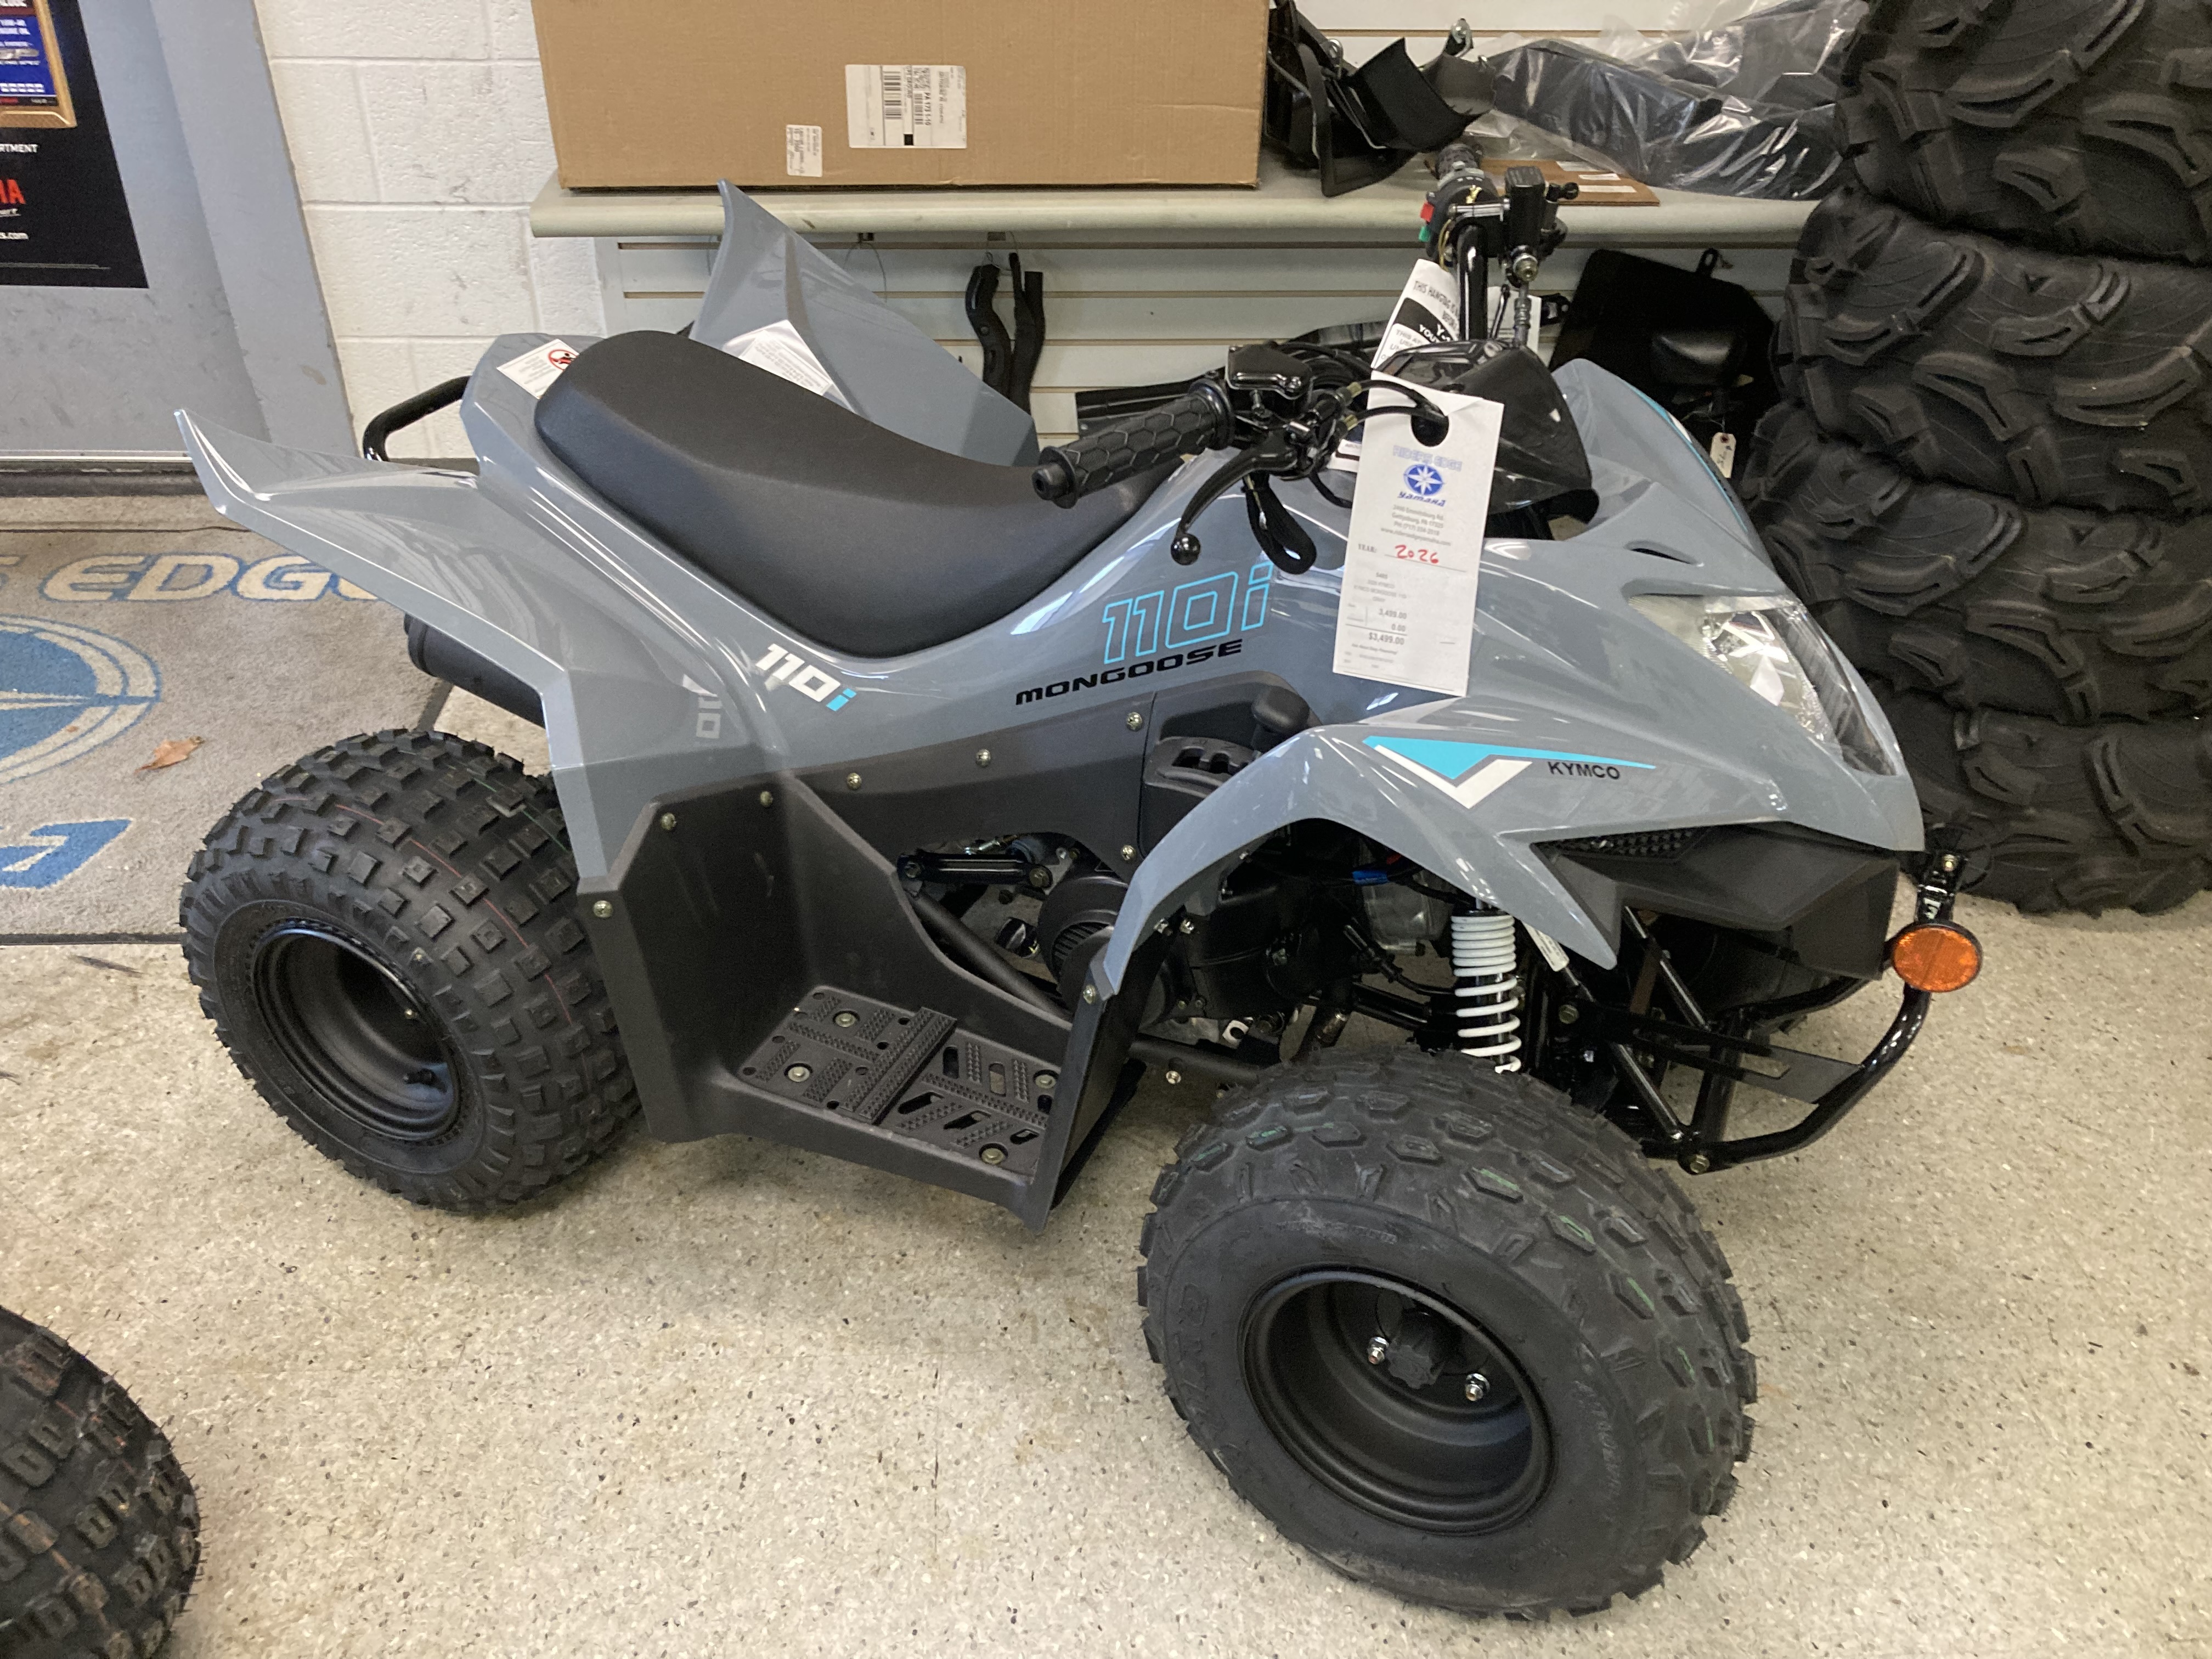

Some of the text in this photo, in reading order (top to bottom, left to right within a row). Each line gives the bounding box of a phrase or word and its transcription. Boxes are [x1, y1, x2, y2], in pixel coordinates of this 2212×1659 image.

[1394, 544, 1440, 565] 2026
[1102, 561, 1274, 664] 110i
[1368, 631, 1405, 646] $3,499.00
[755, 643, 857, 712] 110i
[1015, 639, 1243, 706] MONGOOSE
[1548, 761, 1621, 780] KYMCO
